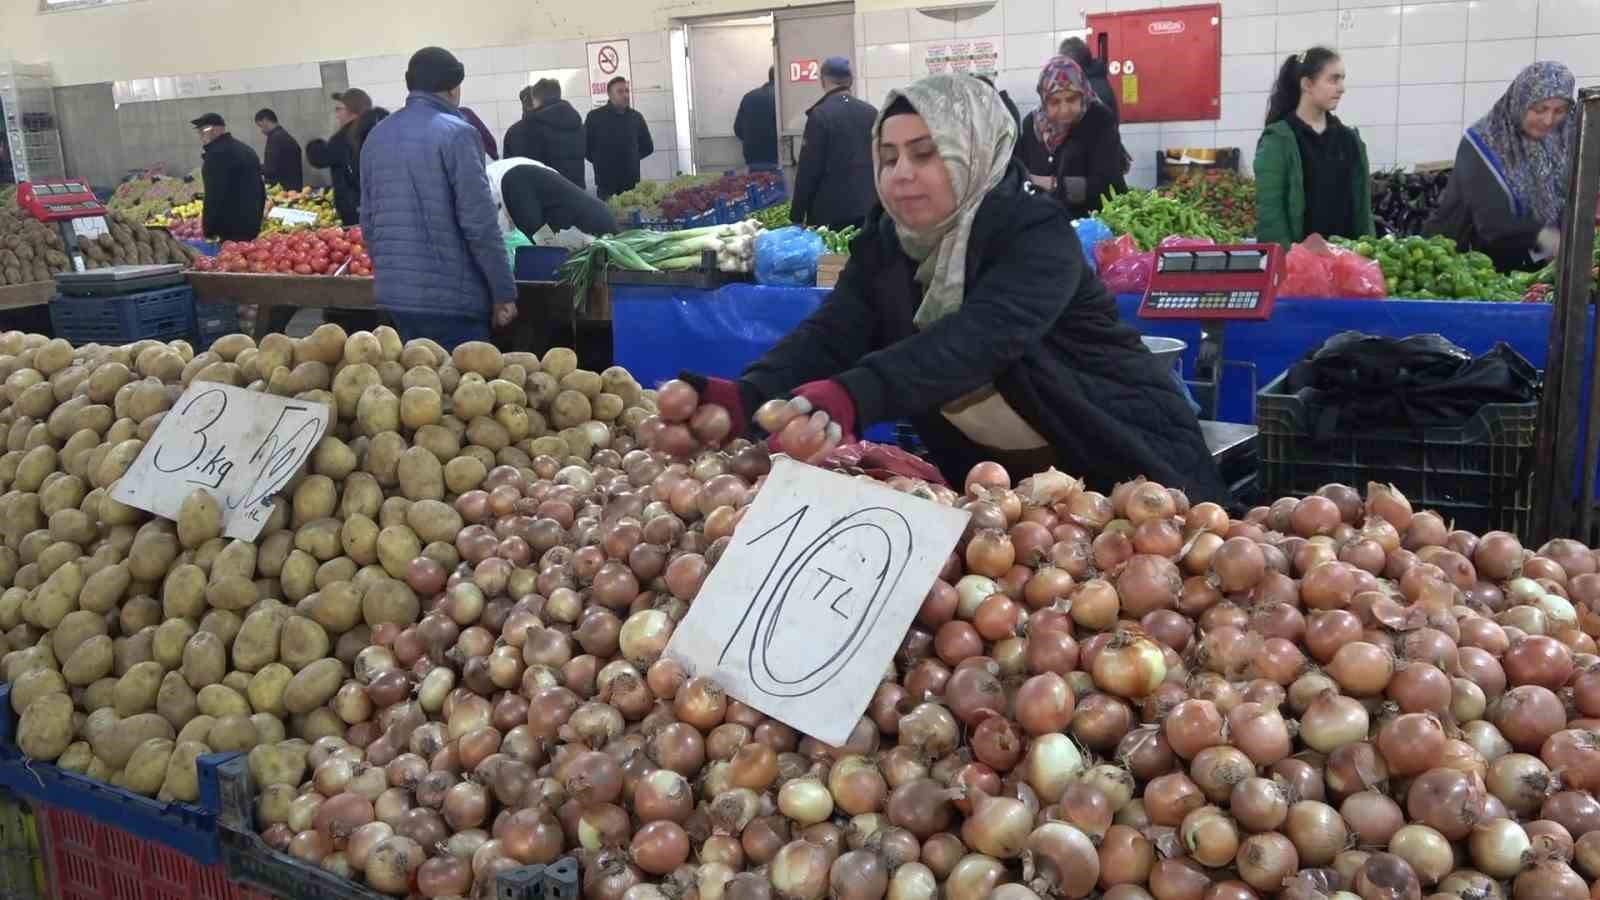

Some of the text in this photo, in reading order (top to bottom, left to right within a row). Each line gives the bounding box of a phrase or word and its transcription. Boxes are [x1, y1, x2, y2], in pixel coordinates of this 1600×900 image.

[790, 61, 817, 80] D-2
[717, 504, 913, 698] 10
[813, 567, 854, 620] TL
